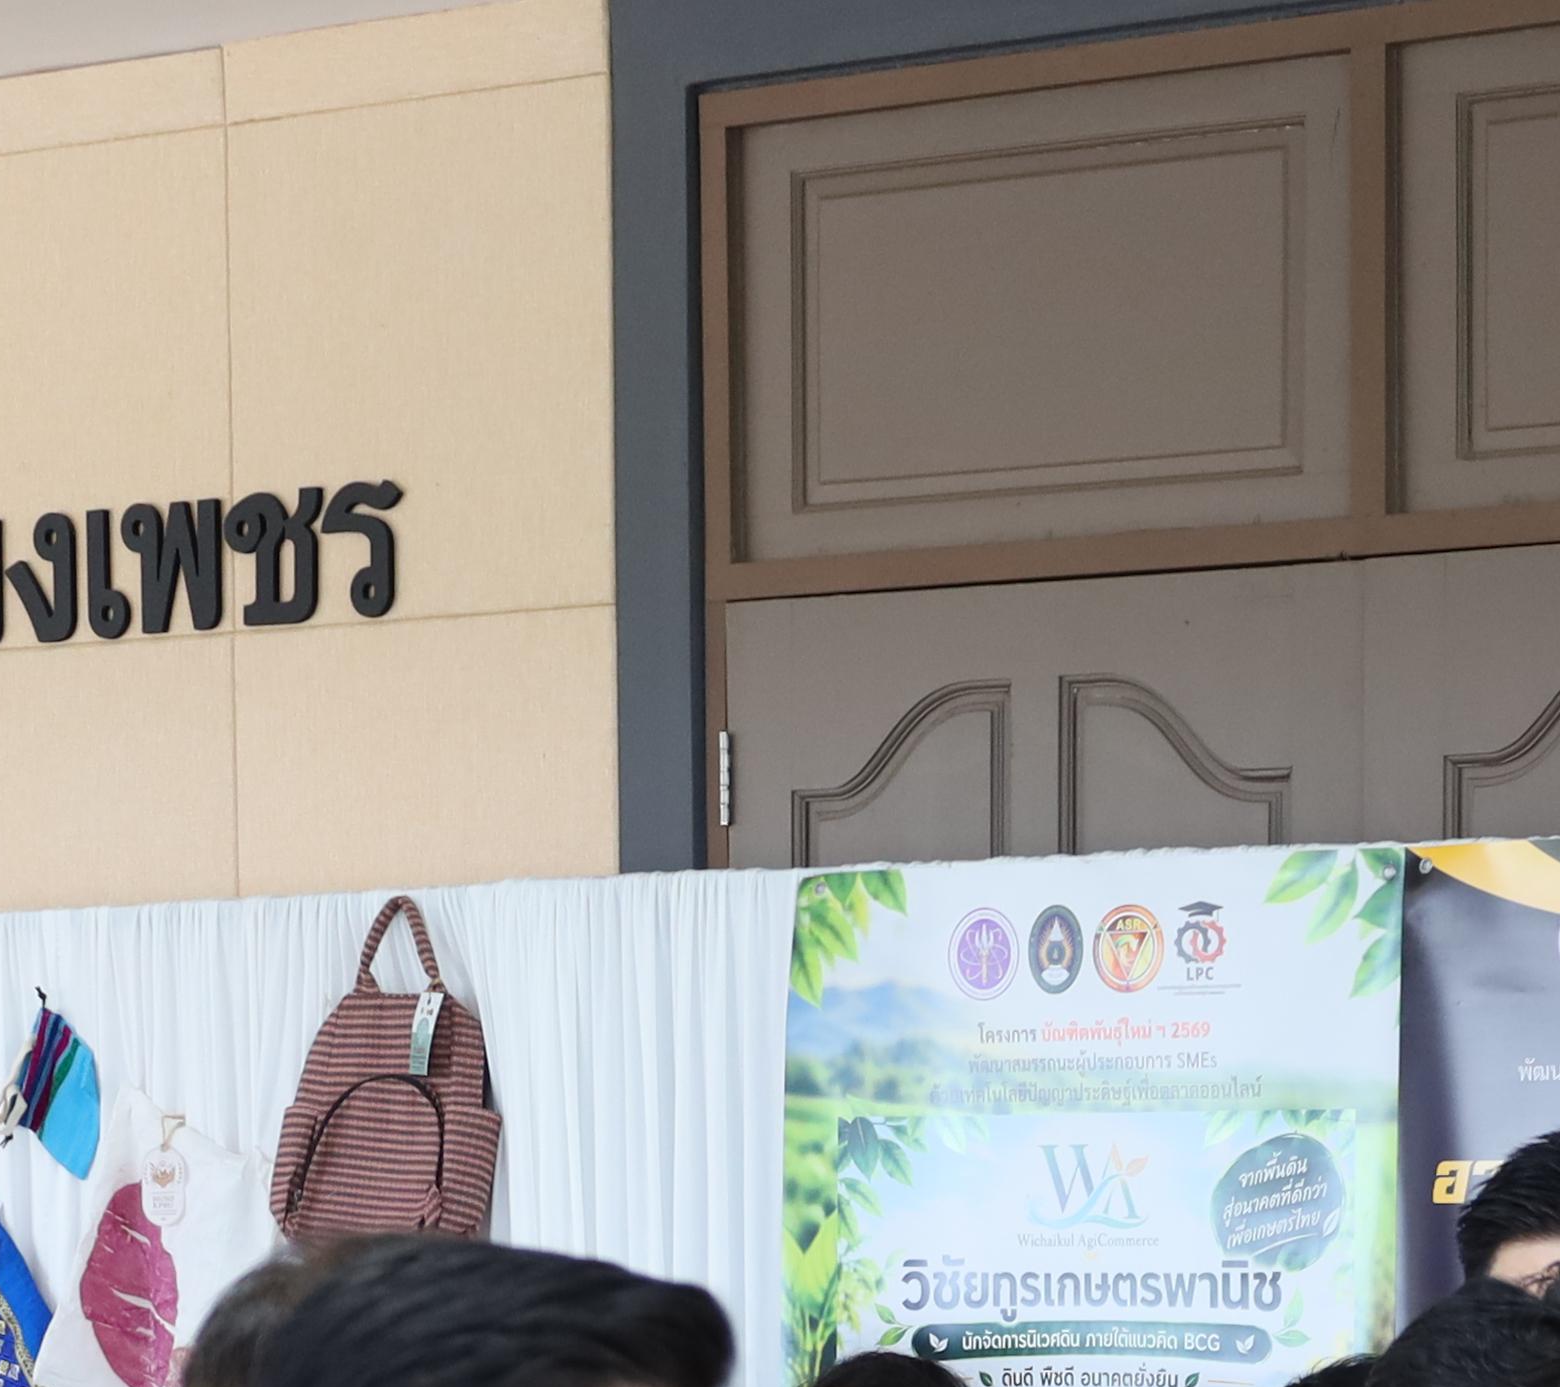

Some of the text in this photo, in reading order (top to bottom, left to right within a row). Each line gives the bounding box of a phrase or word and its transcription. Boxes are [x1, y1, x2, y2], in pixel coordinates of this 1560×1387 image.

[1115, 918, 1142, 931] ASR
[1185, 966, 1215, 981] LPC
[977, 1022, 1037, 1045] โครงการ
[1041, 1016, 1152, 1047] บัณฑิตพันธุ์ใหม่
[1170, 1021, 1211, 1039] 2569
[967, 1051, 1218, 1078] พัฒนาสมรรถนะผู้ประกอบการ SMEs
[1237, 1149, 1308, 1189] จากพื้นดิน
[1222, 1175, 1328, 1228] สู่อนาคตที่ดีกว่า
[1016, 1232, 1160, 1250] Wichaikul AgiCommerce
[1226, 1208, 1321, 1250] เพื่อเกษตรไทย
[961, 1326, 1221, 1352] นักจัดการนิเวศดิน ภายใต้แนวคิด BCG
[1001, 1366, 1033, 1387] ดินดี
[1040, 1366, 1074, 1387] พืชดี
